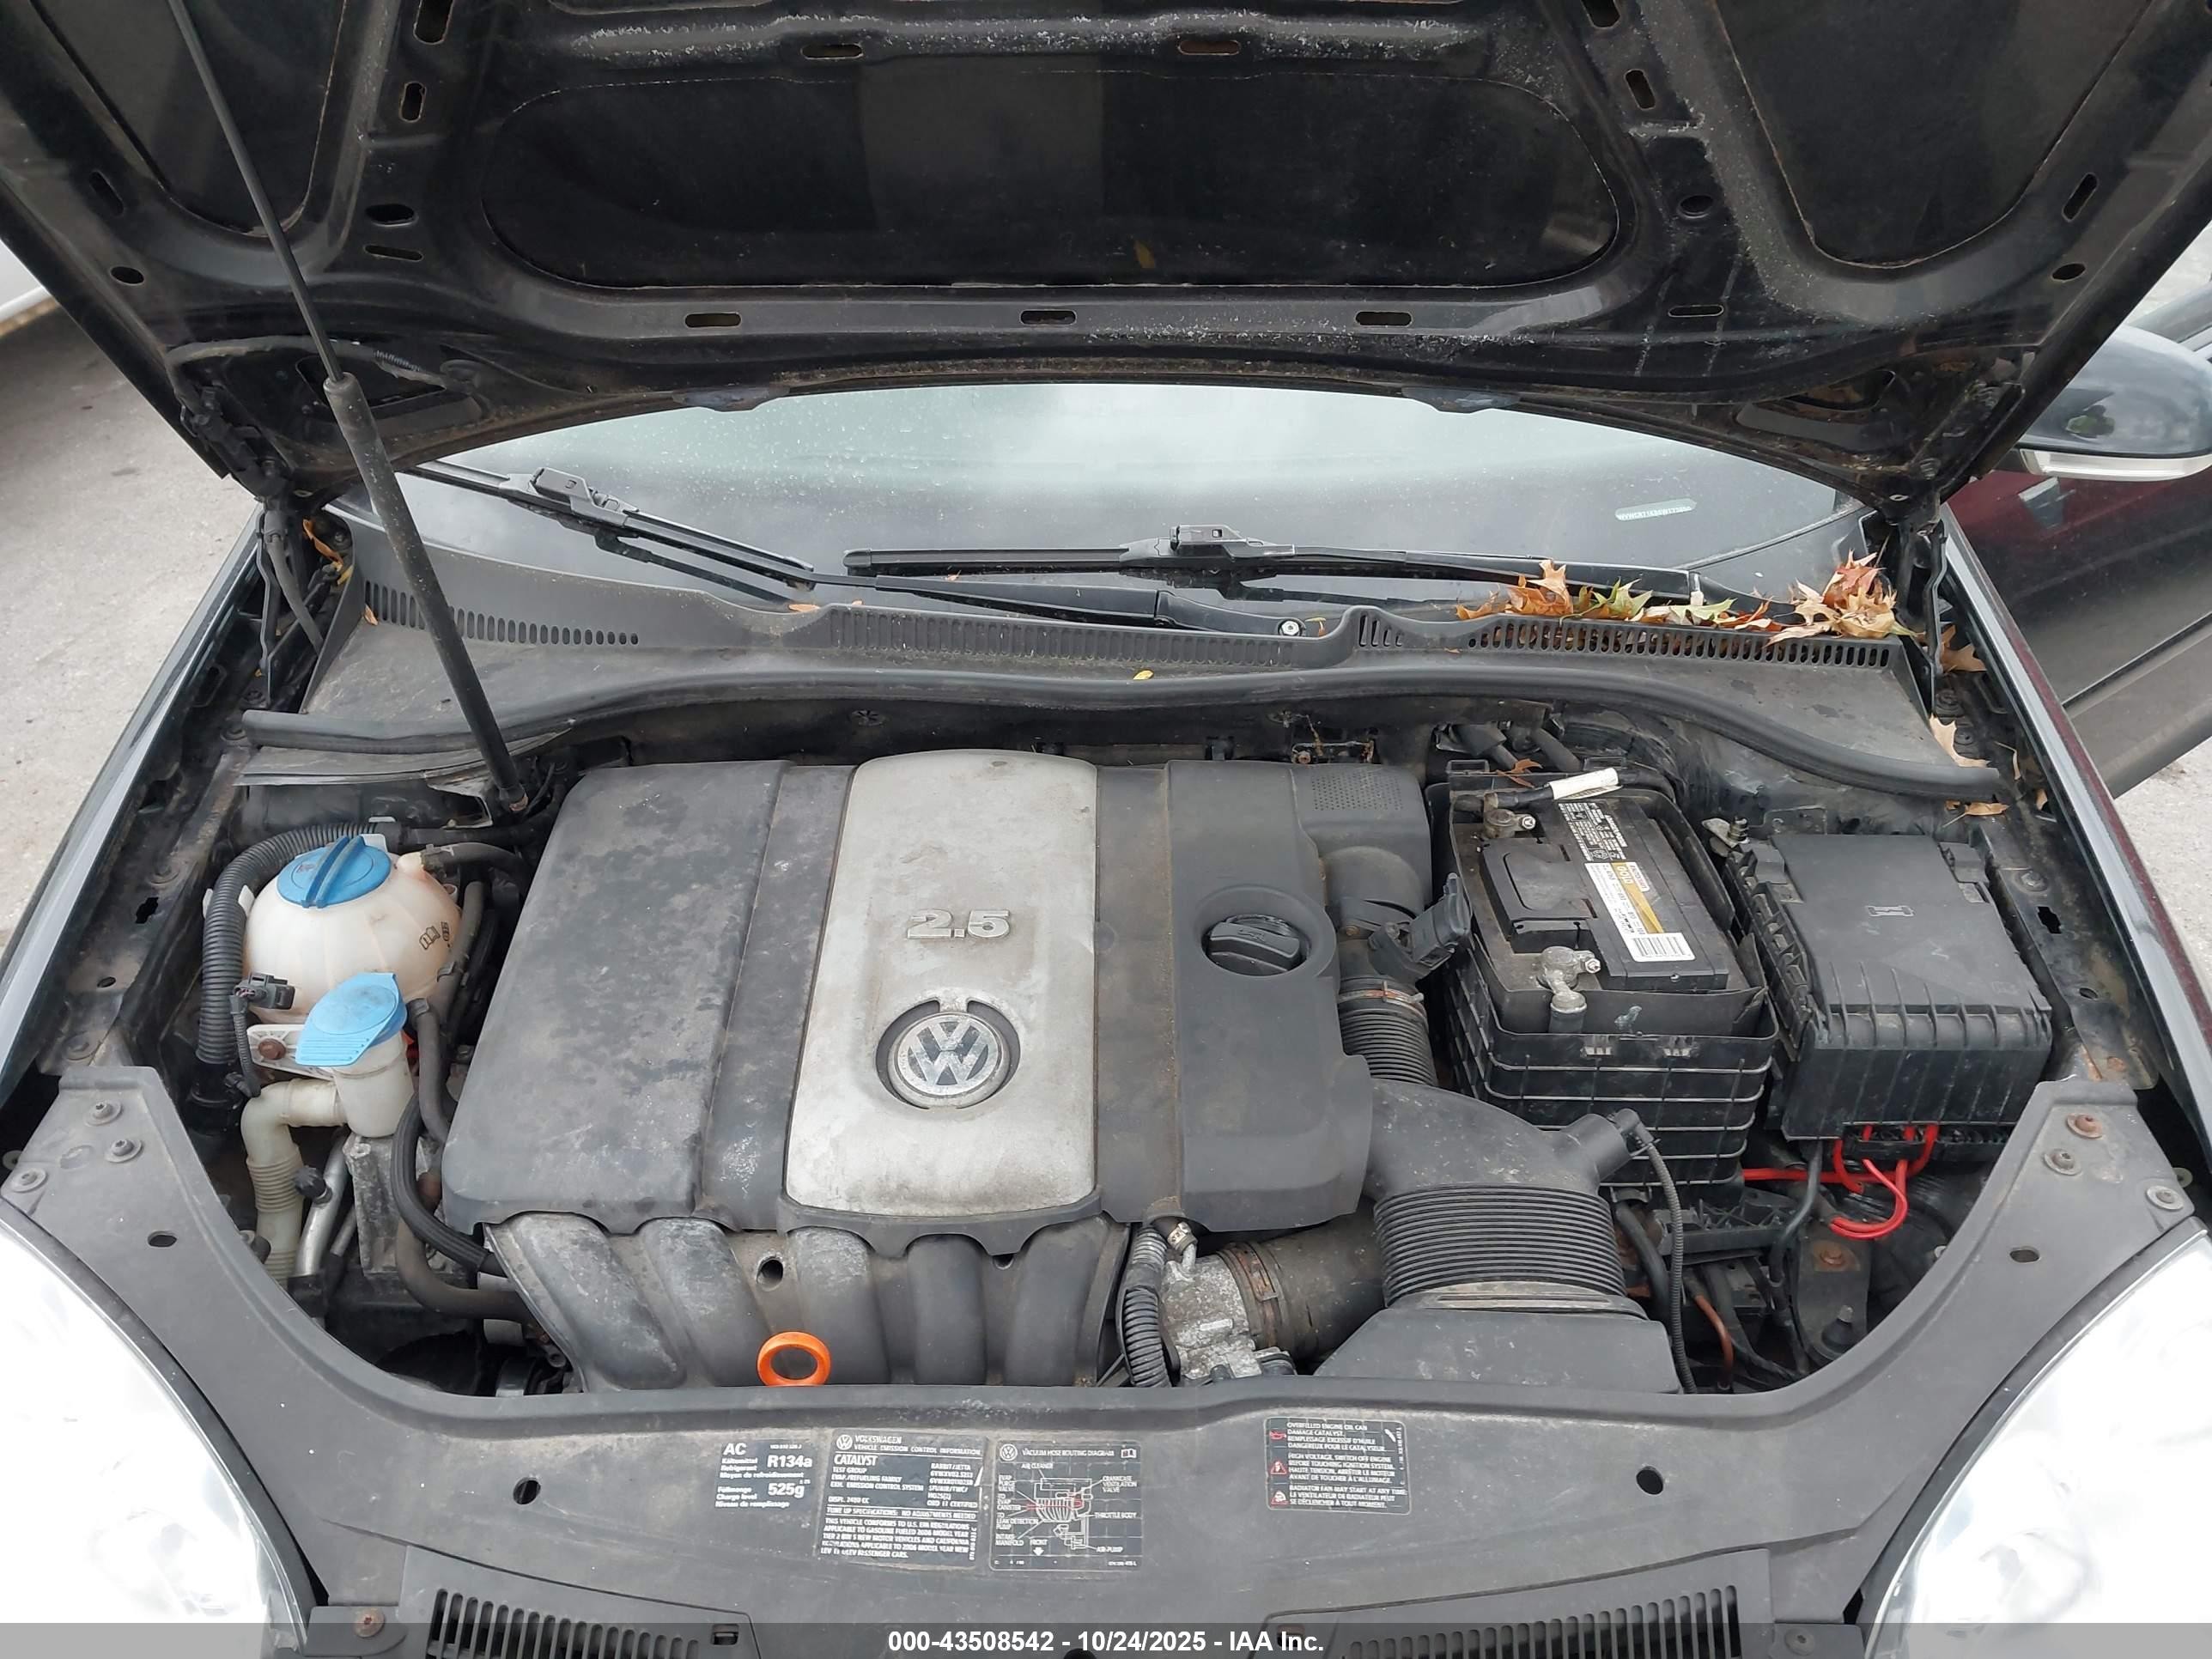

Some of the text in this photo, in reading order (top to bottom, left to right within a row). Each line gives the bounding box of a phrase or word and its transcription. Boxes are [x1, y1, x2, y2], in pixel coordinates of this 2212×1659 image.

[908, 908, 1011, 939] 2.5
[855, 1435, 902, 1444] VOLKSWAGEN
[723, 1443, 747, 1455] AC
[767, 1455, 813, 1468] R134a
[834, 1454, 878, 1466] CATALYST
[768, 1482, 805, 1498] 525g
